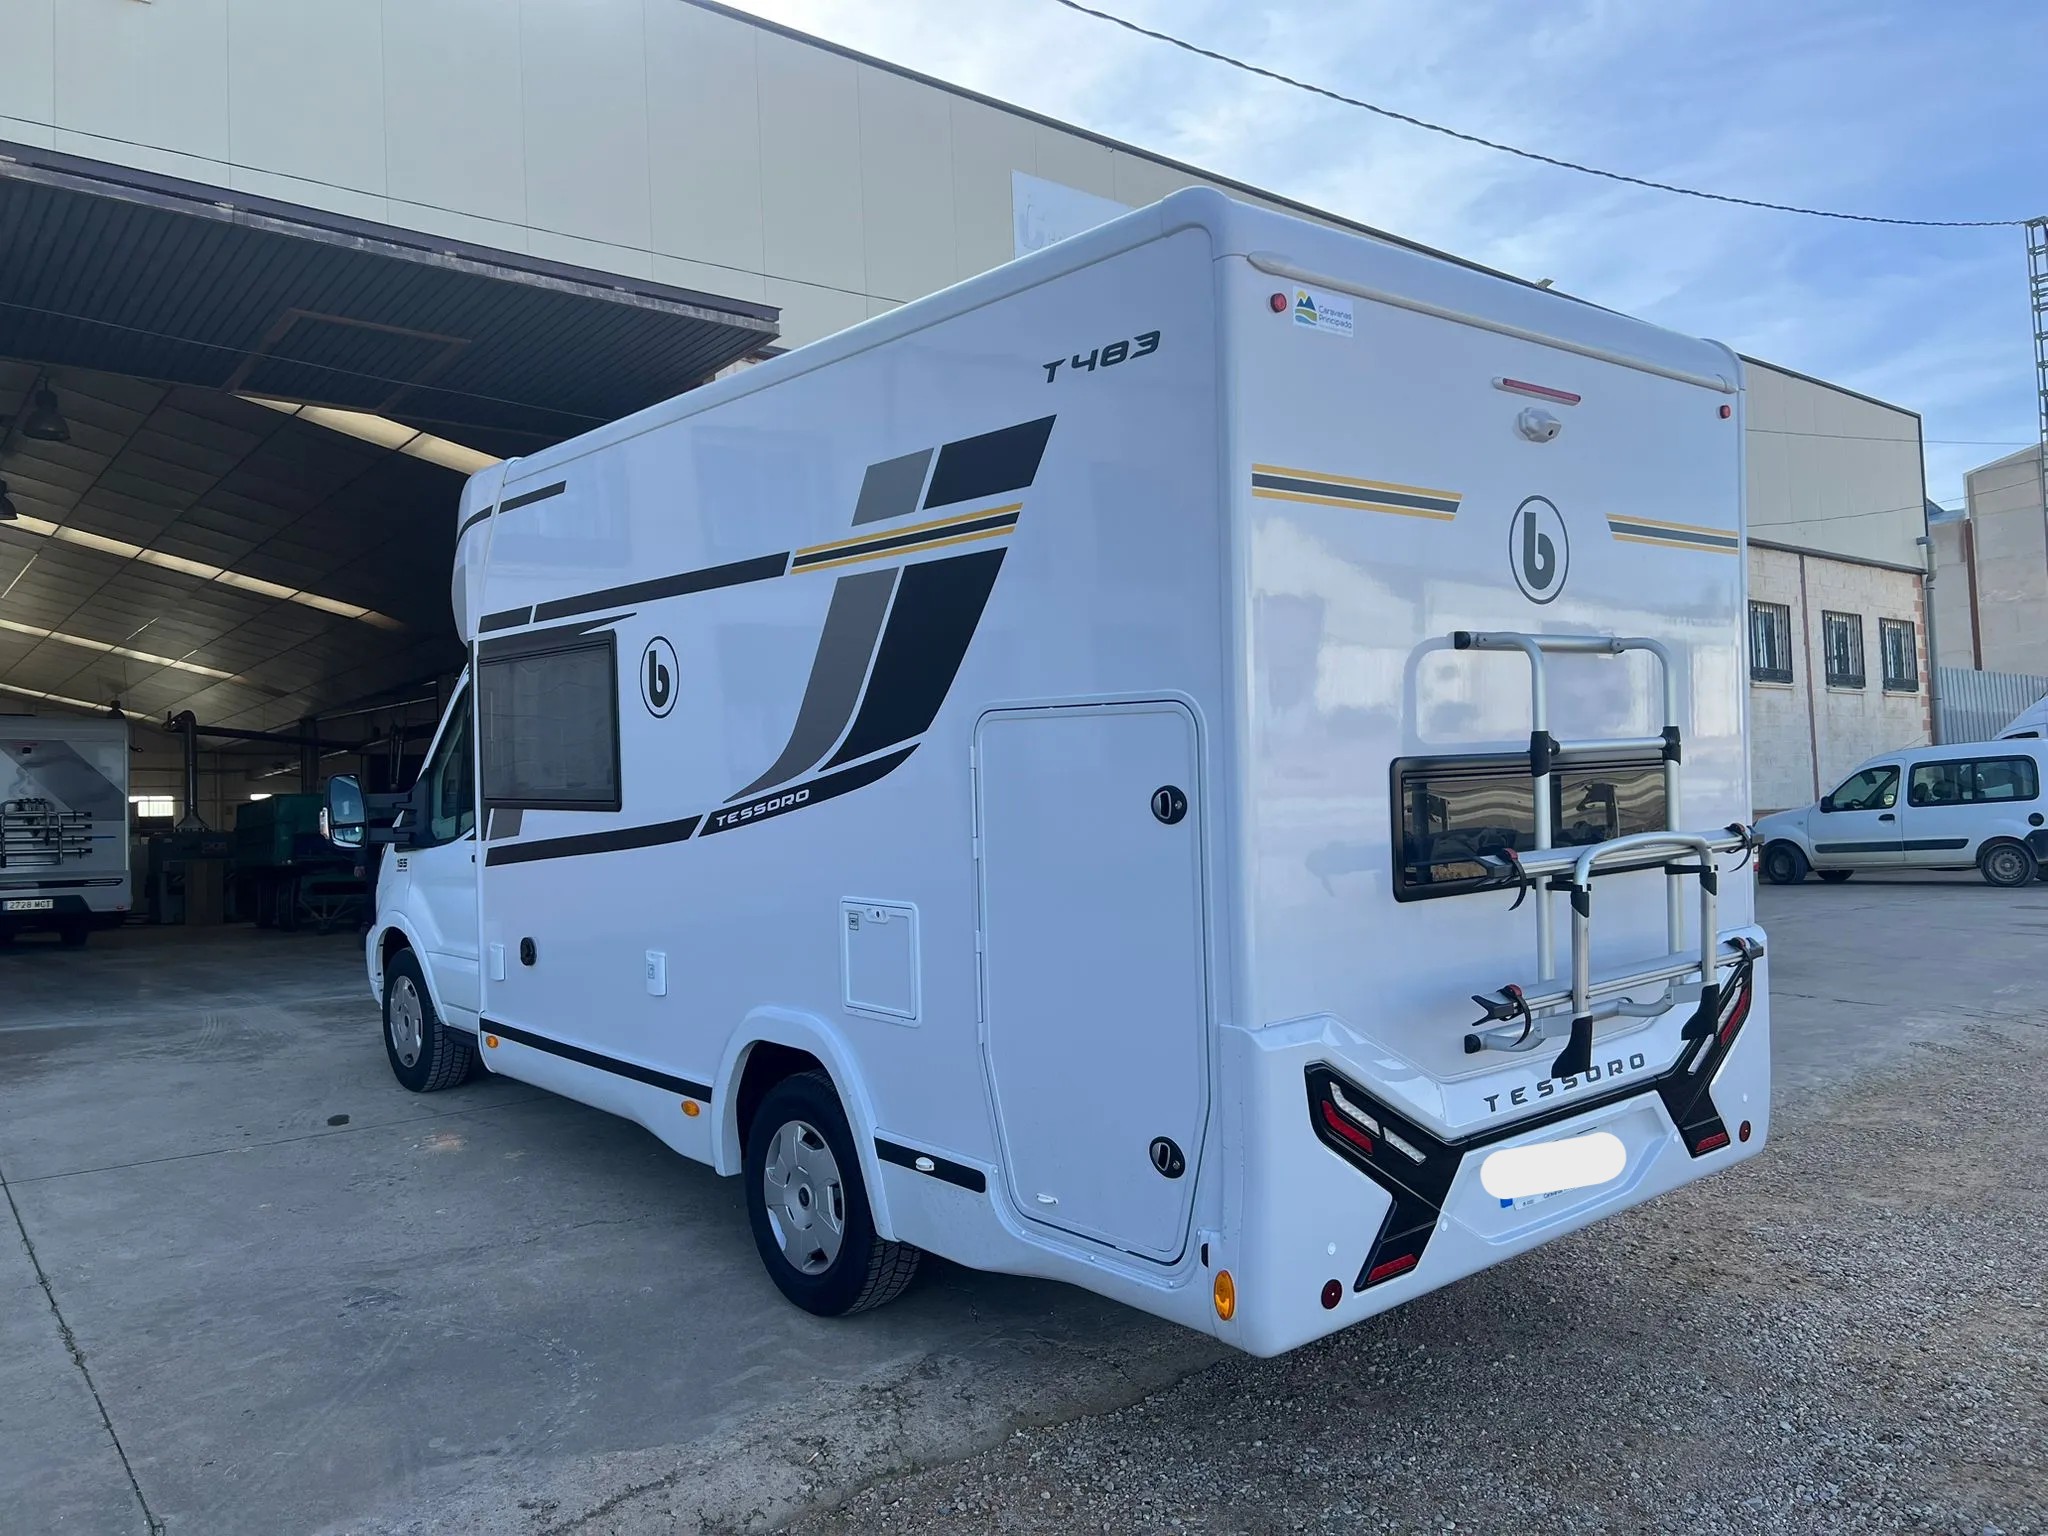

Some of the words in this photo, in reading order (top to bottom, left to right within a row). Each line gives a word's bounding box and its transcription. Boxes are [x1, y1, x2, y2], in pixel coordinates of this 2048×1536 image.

[716, 789, 810, 827] TESSORO
[9, 901, 32, 909] 2728
[1483, 1052, 1645, 1113] TESSORO
